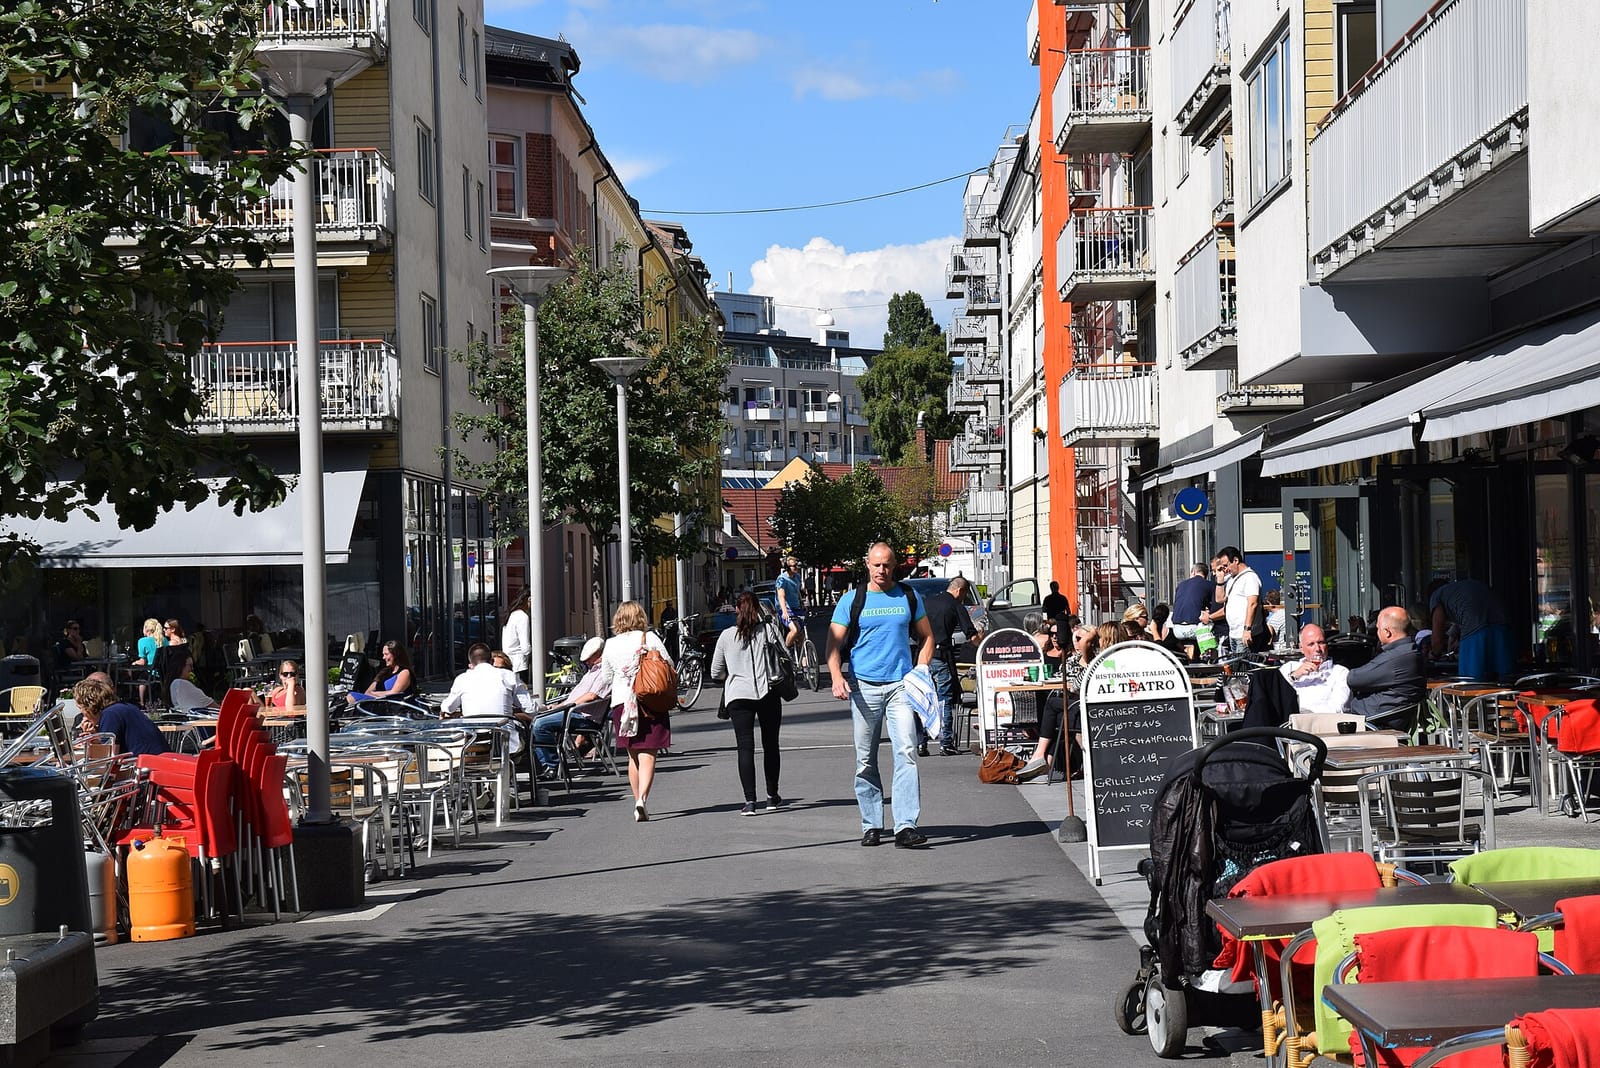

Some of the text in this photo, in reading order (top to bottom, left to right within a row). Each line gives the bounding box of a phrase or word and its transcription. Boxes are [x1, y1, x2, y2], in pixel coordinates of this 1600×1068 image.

[982, 542, 989, 552] P
[986, 669, 1026, 679] LUNSJME
[1096, 671, 1140, 680] RISTORANTE
[1098, 680, 1175, 694] AL TEATRO
[1088, 703, 1176, 719] GRATINERT PASTA
[1092, 737, 1128, 748] ERTER
[1120, 753, 1136, 765] KR
[1094, 775, 1136, 788] GRILLET
[1097, 804, 1132, 815] SALAT
[1126, 819, 1144, 828] KR
